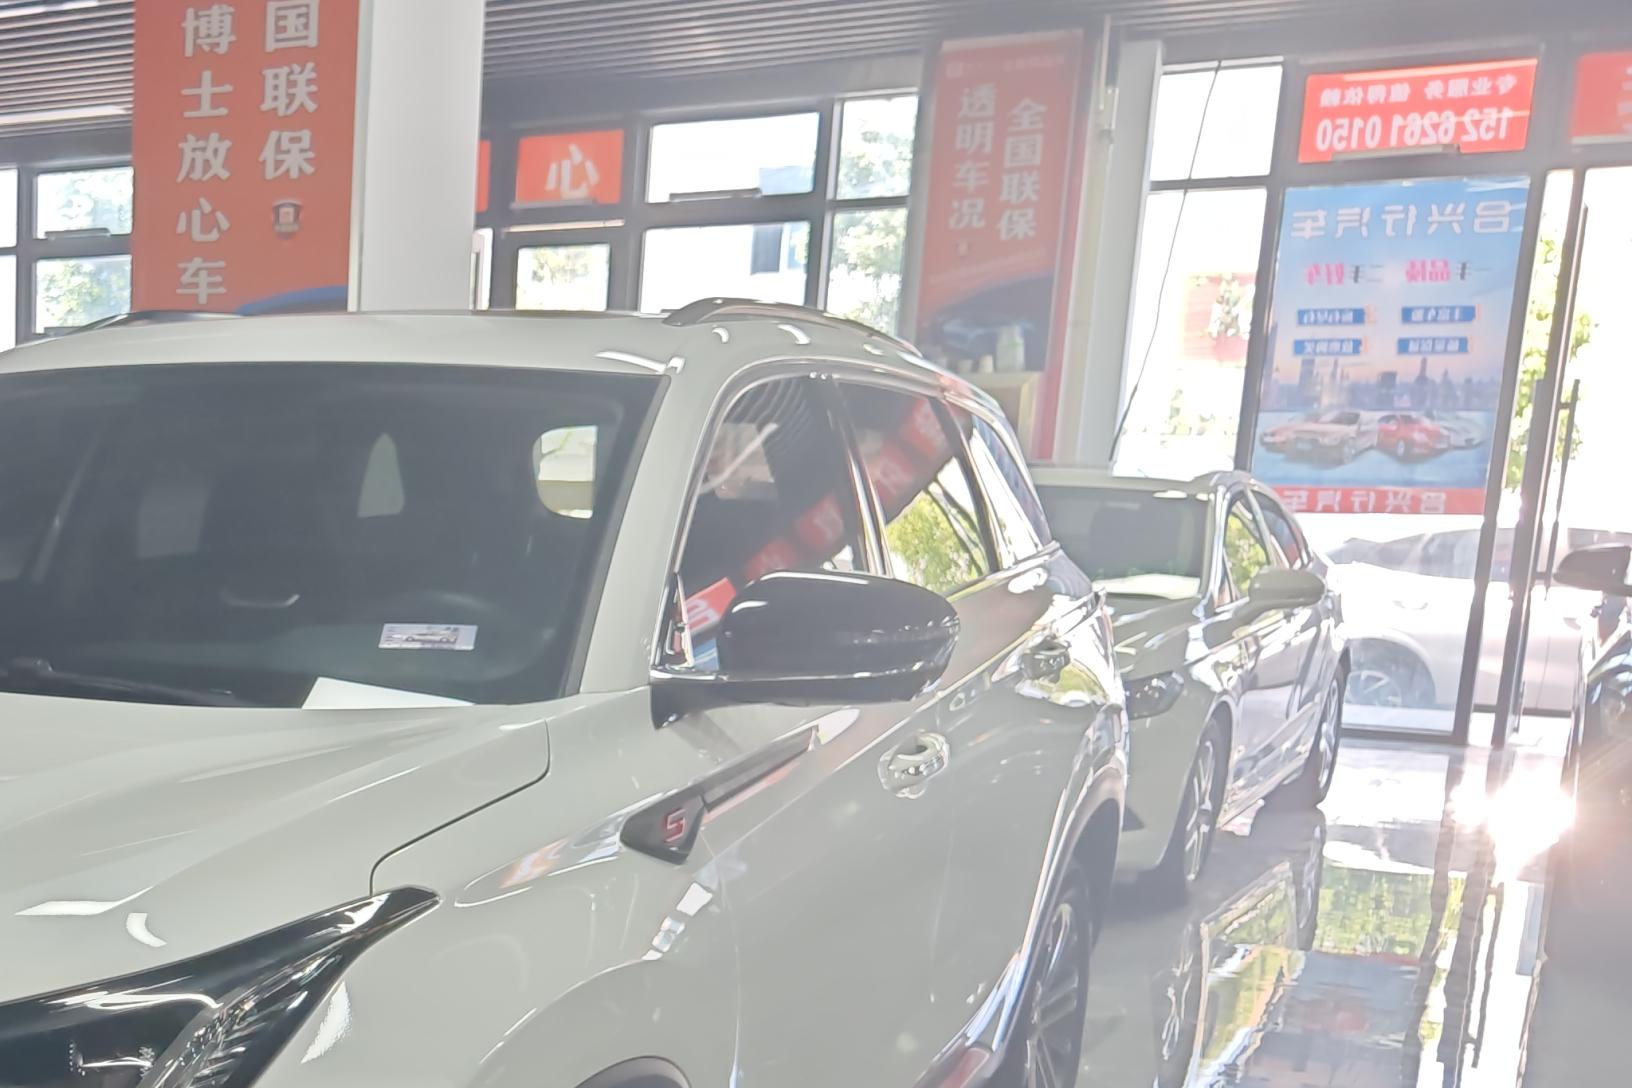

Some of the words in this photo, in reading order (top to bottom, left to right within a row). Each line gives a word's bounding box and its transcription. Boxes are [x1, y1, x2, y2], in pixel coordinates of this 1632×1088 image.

[176, 5, 236, 305] 博士放心车
[259, 0, 320, 181] 国联保
[948, 82, 998, 231] 透明车况
[544, 143, 600, 199] 心
[996, 97, 1048, 241] 全国联保
